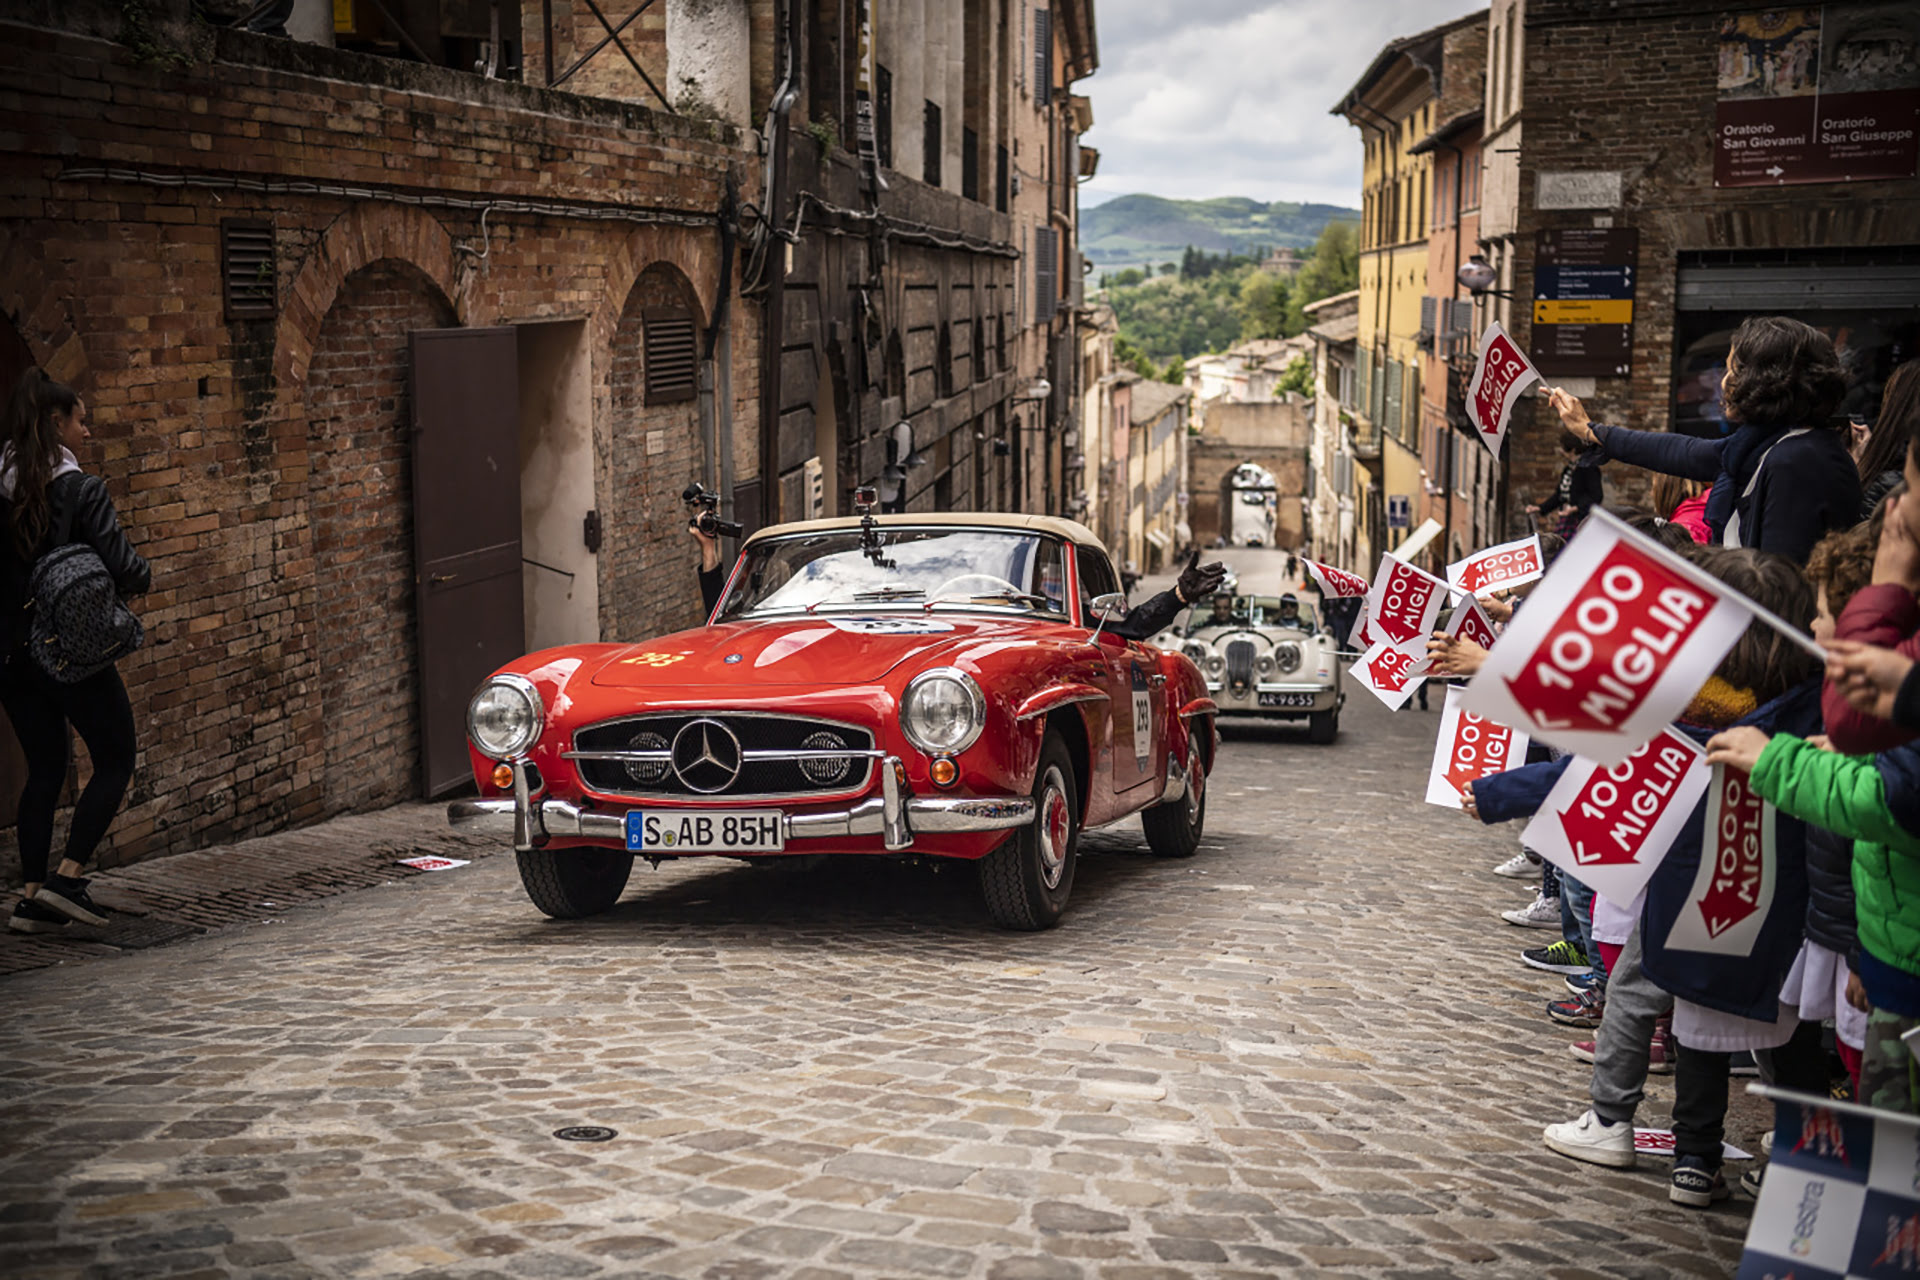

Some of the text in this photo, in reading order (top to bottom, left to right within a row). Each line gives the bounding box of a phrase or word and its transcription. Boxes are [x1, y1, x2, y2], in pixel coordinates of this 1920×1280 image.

[1723, 123, 1775, 136] Oratorio
[1821, 127, 1914, 144] San Giuseppe
[1822, 116, 1876, 131] Oratorio
[1722, 134, 1806, 150] San Giovanni
[1480, 347, 1502, 403] 1000
[1489, 360, 1521, 426] MIGLIA
[1475, 550, 1528, 572] 1000
[1475, 561, 1535, 588] MIGLIA
[1384, 564, 1413, 618] 1000
[1402, 577, 1432, 630] MIGLI
[1535, 564, 1644, 690] 1000
[1378, 652, 1398, 670] 10
[1579, 587, 1704, 726] MIGLIA
[1135, 699, 1149, 732] 293
[1260, 694, 1313, 706] AR-96-55
[1609, 746, 1688, 852] MIGLIA
[631, 834, 639, 844] D
[644, 816, 778, 846] S AB 85H
[1716, 779, 1741, 893] 1000
[1737, 782, 1760, 904] MIGLI
